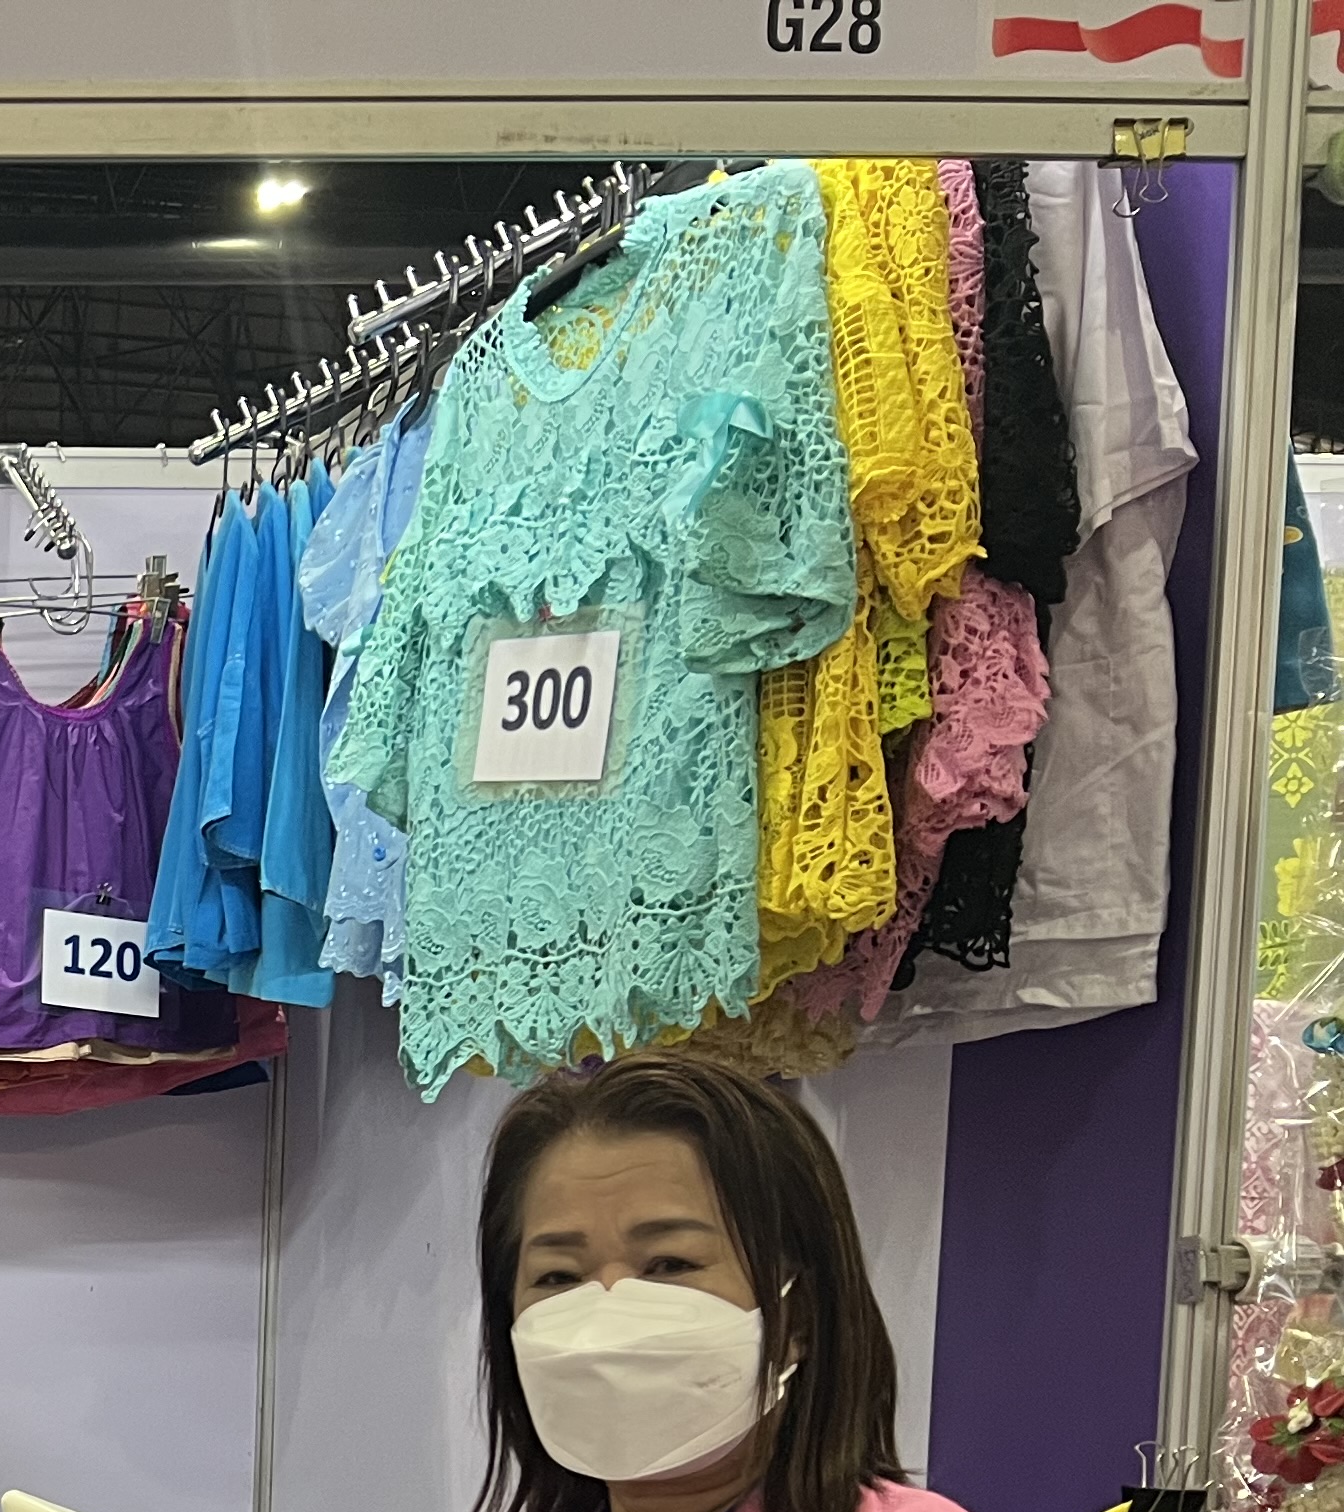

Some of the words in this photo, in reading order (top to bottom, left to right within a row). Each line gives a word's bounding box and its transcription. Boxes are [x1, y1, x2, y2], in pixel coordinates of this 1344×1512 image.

[767, 0, 881, 54] G28
[502, 666, 592, 731] 300
[64, 935, 141, 981] 120
